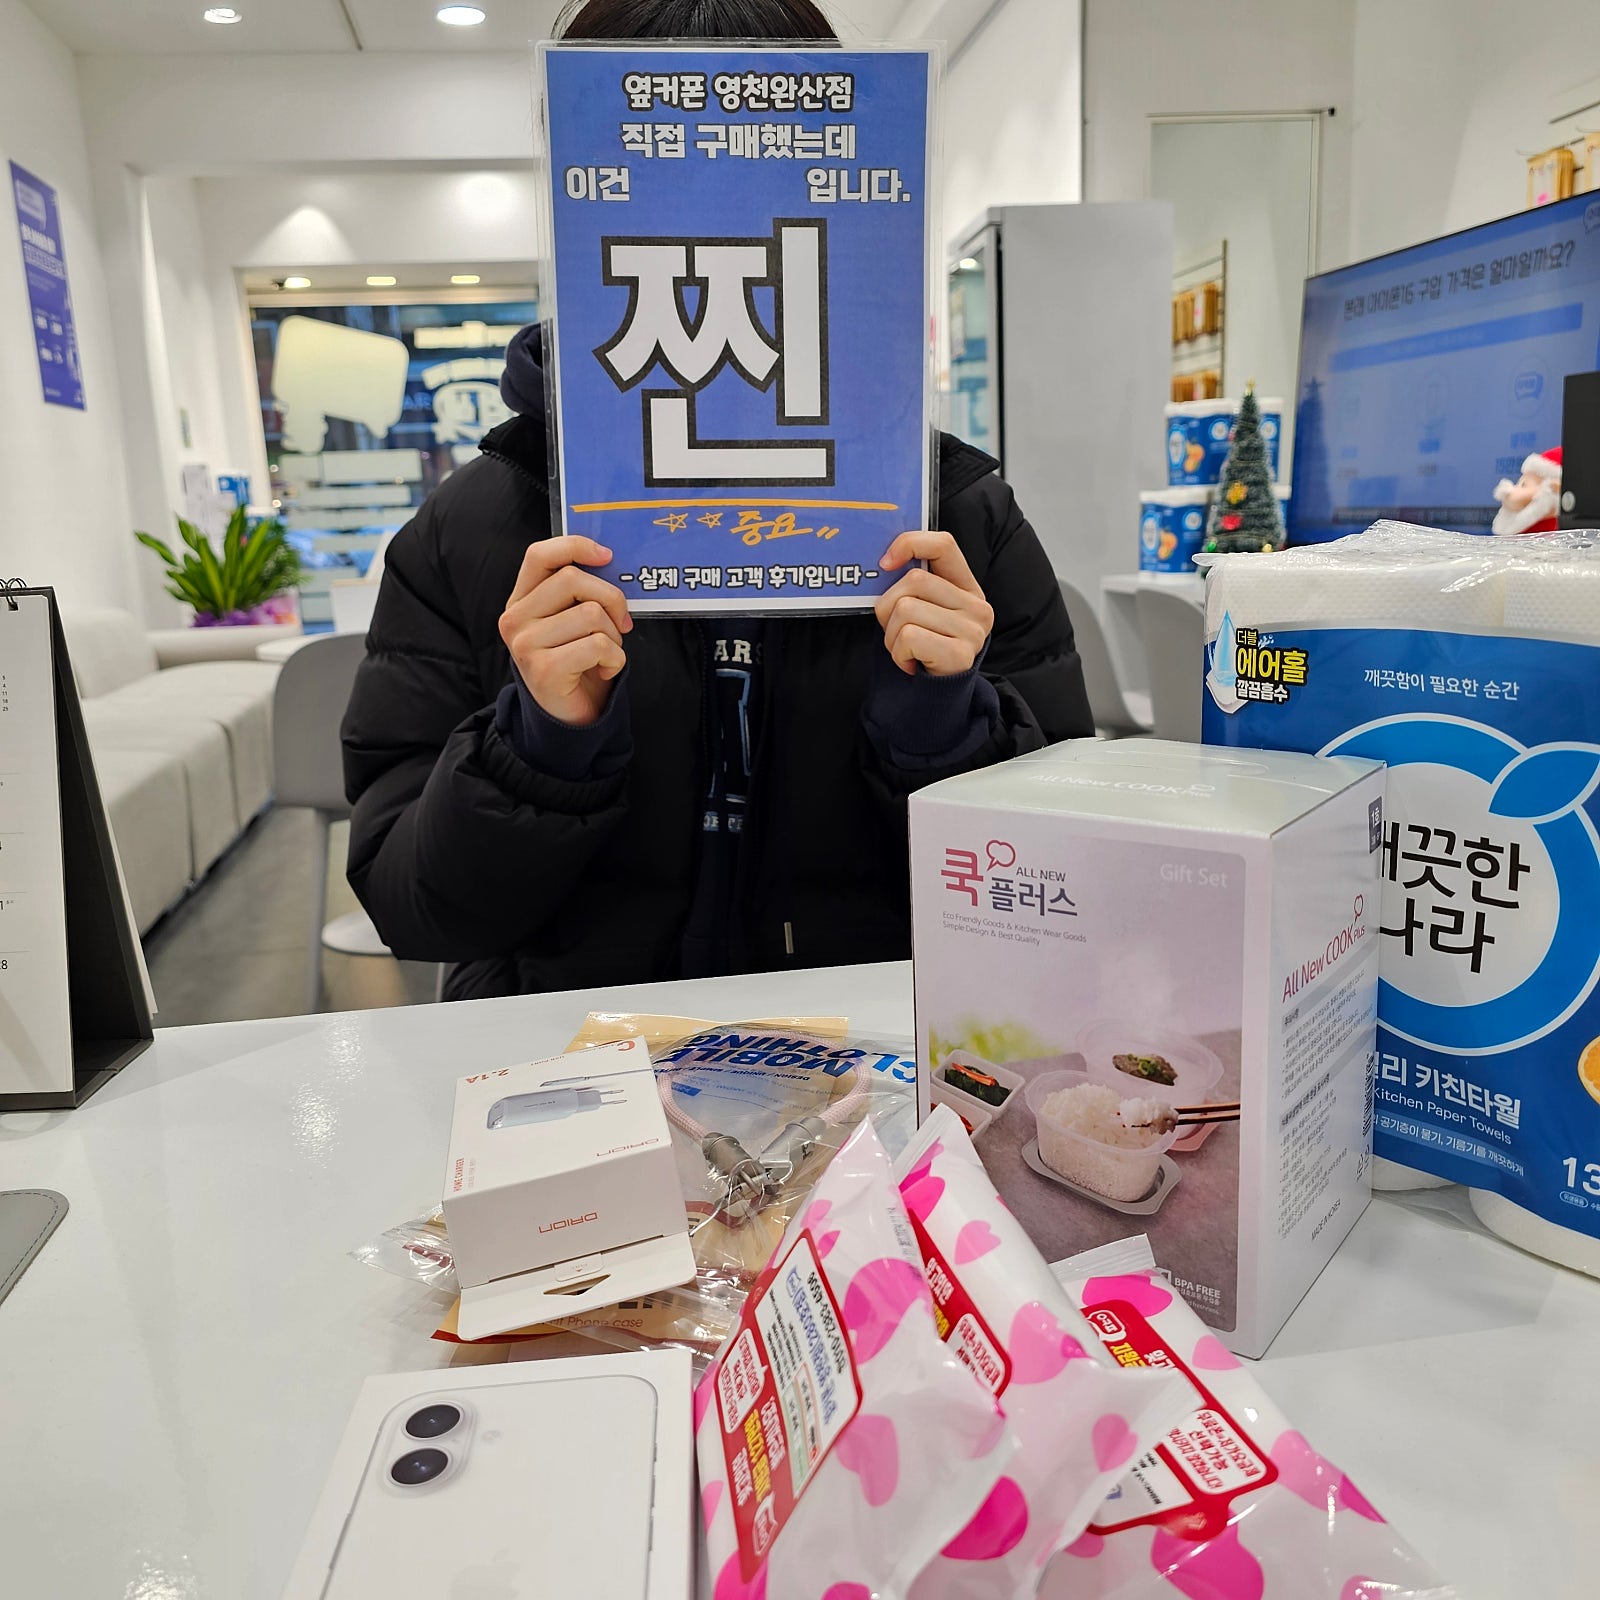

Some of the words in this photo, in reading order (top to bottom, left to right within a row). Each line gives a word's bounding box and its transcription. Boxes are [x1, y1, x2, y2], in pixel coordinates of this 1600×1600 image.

[623, 73, 706, 110] 옆커폰
[714, 73, 853, 111] 영천완산점
[621, 124, 686, 159] 직접
[696, 124, 856, 160] 구매했는데
[565, 167, 630, 202] 이건
[806, 168, 912, 203] 입니다.
[1490, 240, 1575, 286] 얼마일까요?
[600, 222, 830, 484] 찐
[638, 567, 678, 590] 실제
[684, 566, 722, 589] 구매
[726, 566, 764, 588] 고객
[769, 565, 862, 587] 후기입니다
[1237, 629, 1257, 645] 더블
[1237, 648, 1306, 683] 에어홀
[1236, 680, 1289, 702] 깔끔흡수
[1364, 669, 1426, 691] 깨끗함이
[1430, 677, 1479, 698] 필요한
[1483, 681, 1520, 701] 순간
[1113, 781, 1183, 795] COOK
[940, 847, 984, 907] 쿡
[1016, 866, 1038, 879] ALL
[1040, 869, 1066, 882] NEW
[1160, 863, 1194, 883] Gift
[1198, 868, 1228, 889] Set
[988, 876, 1078, 917] 플러스
[943, 911, 955, 920] Eco
[955, 913, 982, 926] Friendly
[983, 917, 1005, 929] Goods
[1014, 923, 1042, 935] Kitchen
[1042, 928, 1062, 938] Wear
[1063, 931, 1087, 943] Goods
[943, 920, 965, 931] Simple
[965, 924, 989, 937] Design
[998, 931, 1014, 941] Best
[1015, 933, 1041, 946] Quality
[1282, 969, 1299, 1004] All
[1301, 953, 1324, 988] New
[1326, 923, 1354, 966] COOK
[465, 1068, 510, 1084] 2.1A
[1375, 1051, 1407, 1086] 리
[1415, 1063, 1521, 1129] 키친타월
[1427, 1101, 1467, 1125] Paper
[1469, 1114, 1512, 1145] Towels
[1174, 1277, 1194, 1291] BPA
[1196, 1284, 1221, 1299] FREE
[613, 1318, 643, 1328] case
